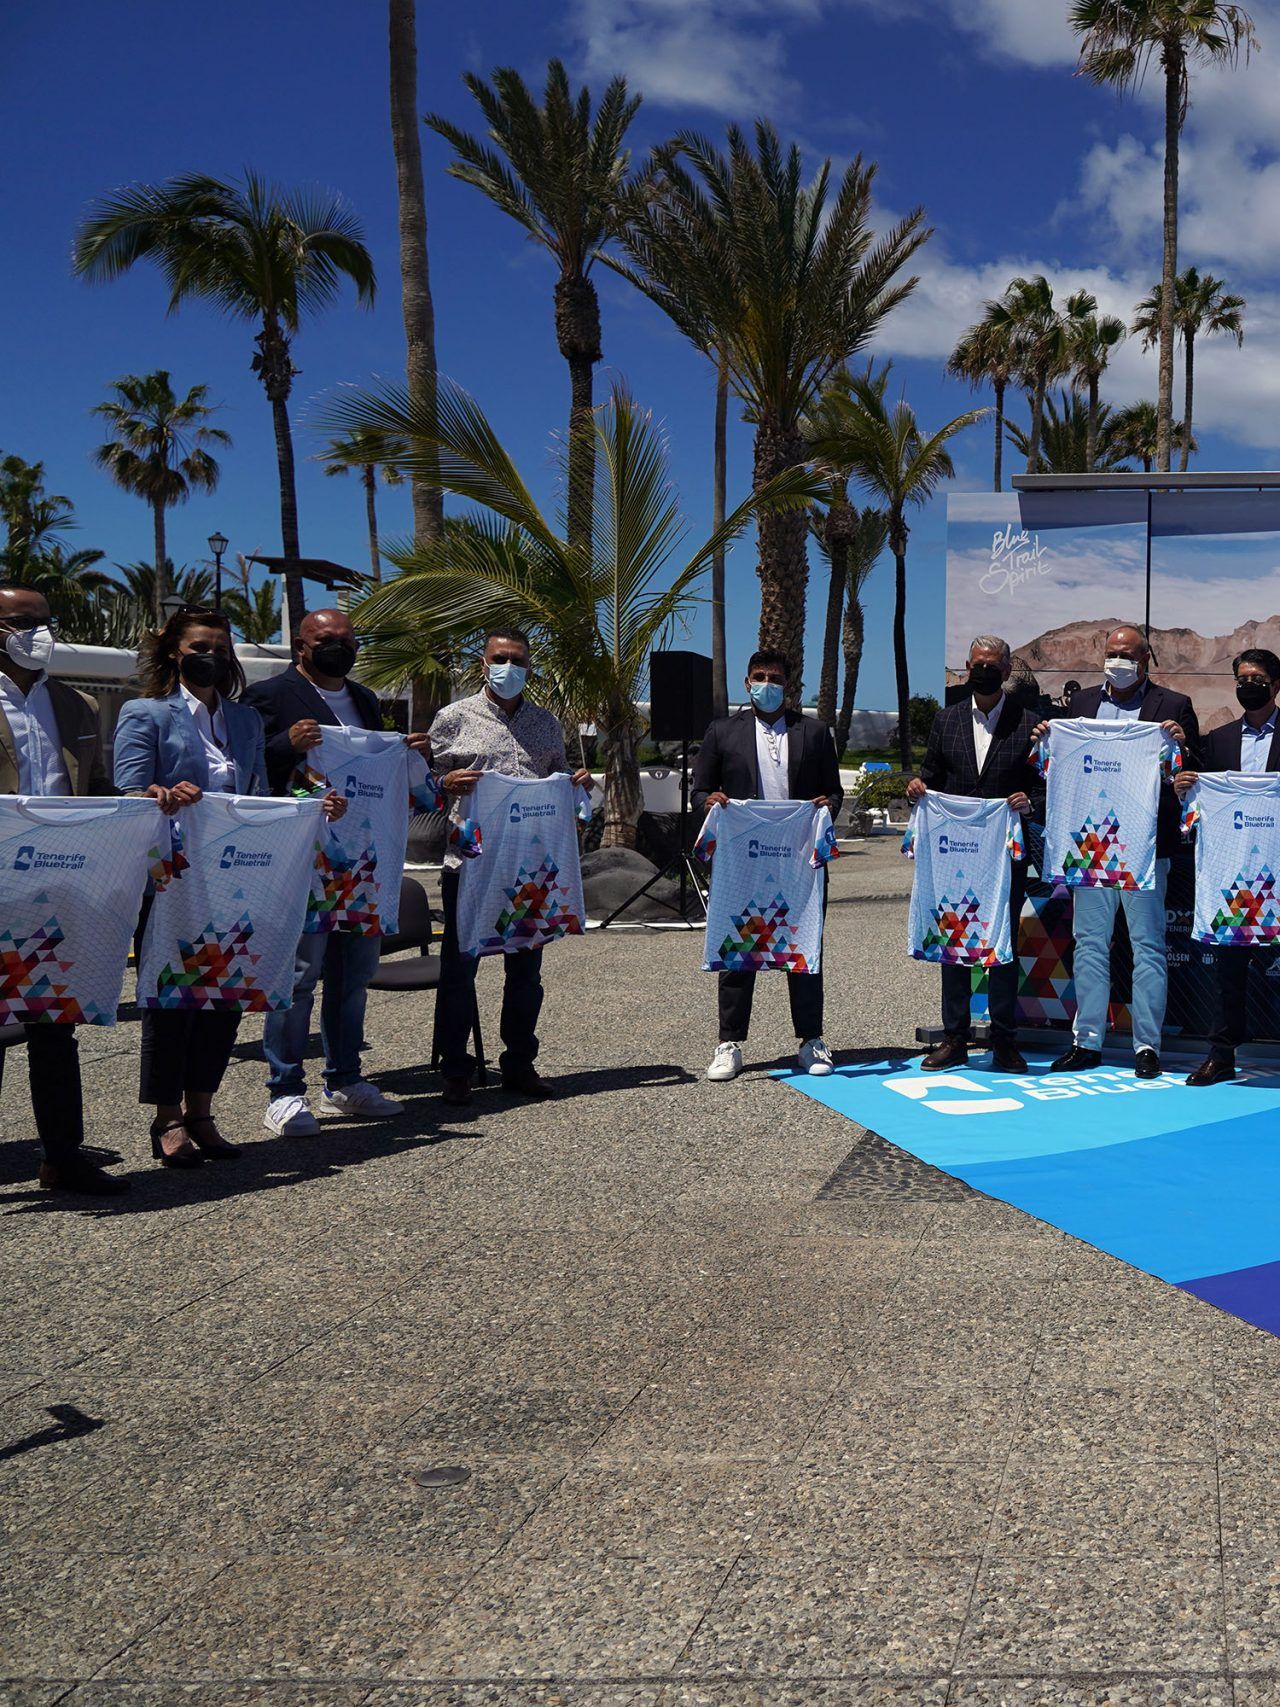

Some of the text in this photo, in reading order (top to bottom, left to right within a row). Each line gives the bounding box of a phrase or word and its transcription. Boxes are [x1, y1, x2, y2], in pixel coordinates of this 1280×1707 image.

[991, 523, 1029, 560] Blue
[1001, 534, 1048, 570] Trail
[979, 560, 1052, 596] Spirit
[1093, 759, 1122, 767] Tenerife
[1093, 765, 1122, 773] Bluetrail
[521, 803, 556, 812] Tenerife
[522, 810, 556, 819] Bluetrail
[1244, 821, 1275, 829] Bluetrail
[760, 844, 792, 852] Tenerife
[949, 846, 979, 854] Bluetrail
[37, 852, 86, 862] Tenerife
[236, 851, 273, 860] Tenerife
[759, 850, 792, 858] Bluetrail
[33, 860, 84, 870] Bluetrail
[233, 859, 272, 867] Bluetrail
